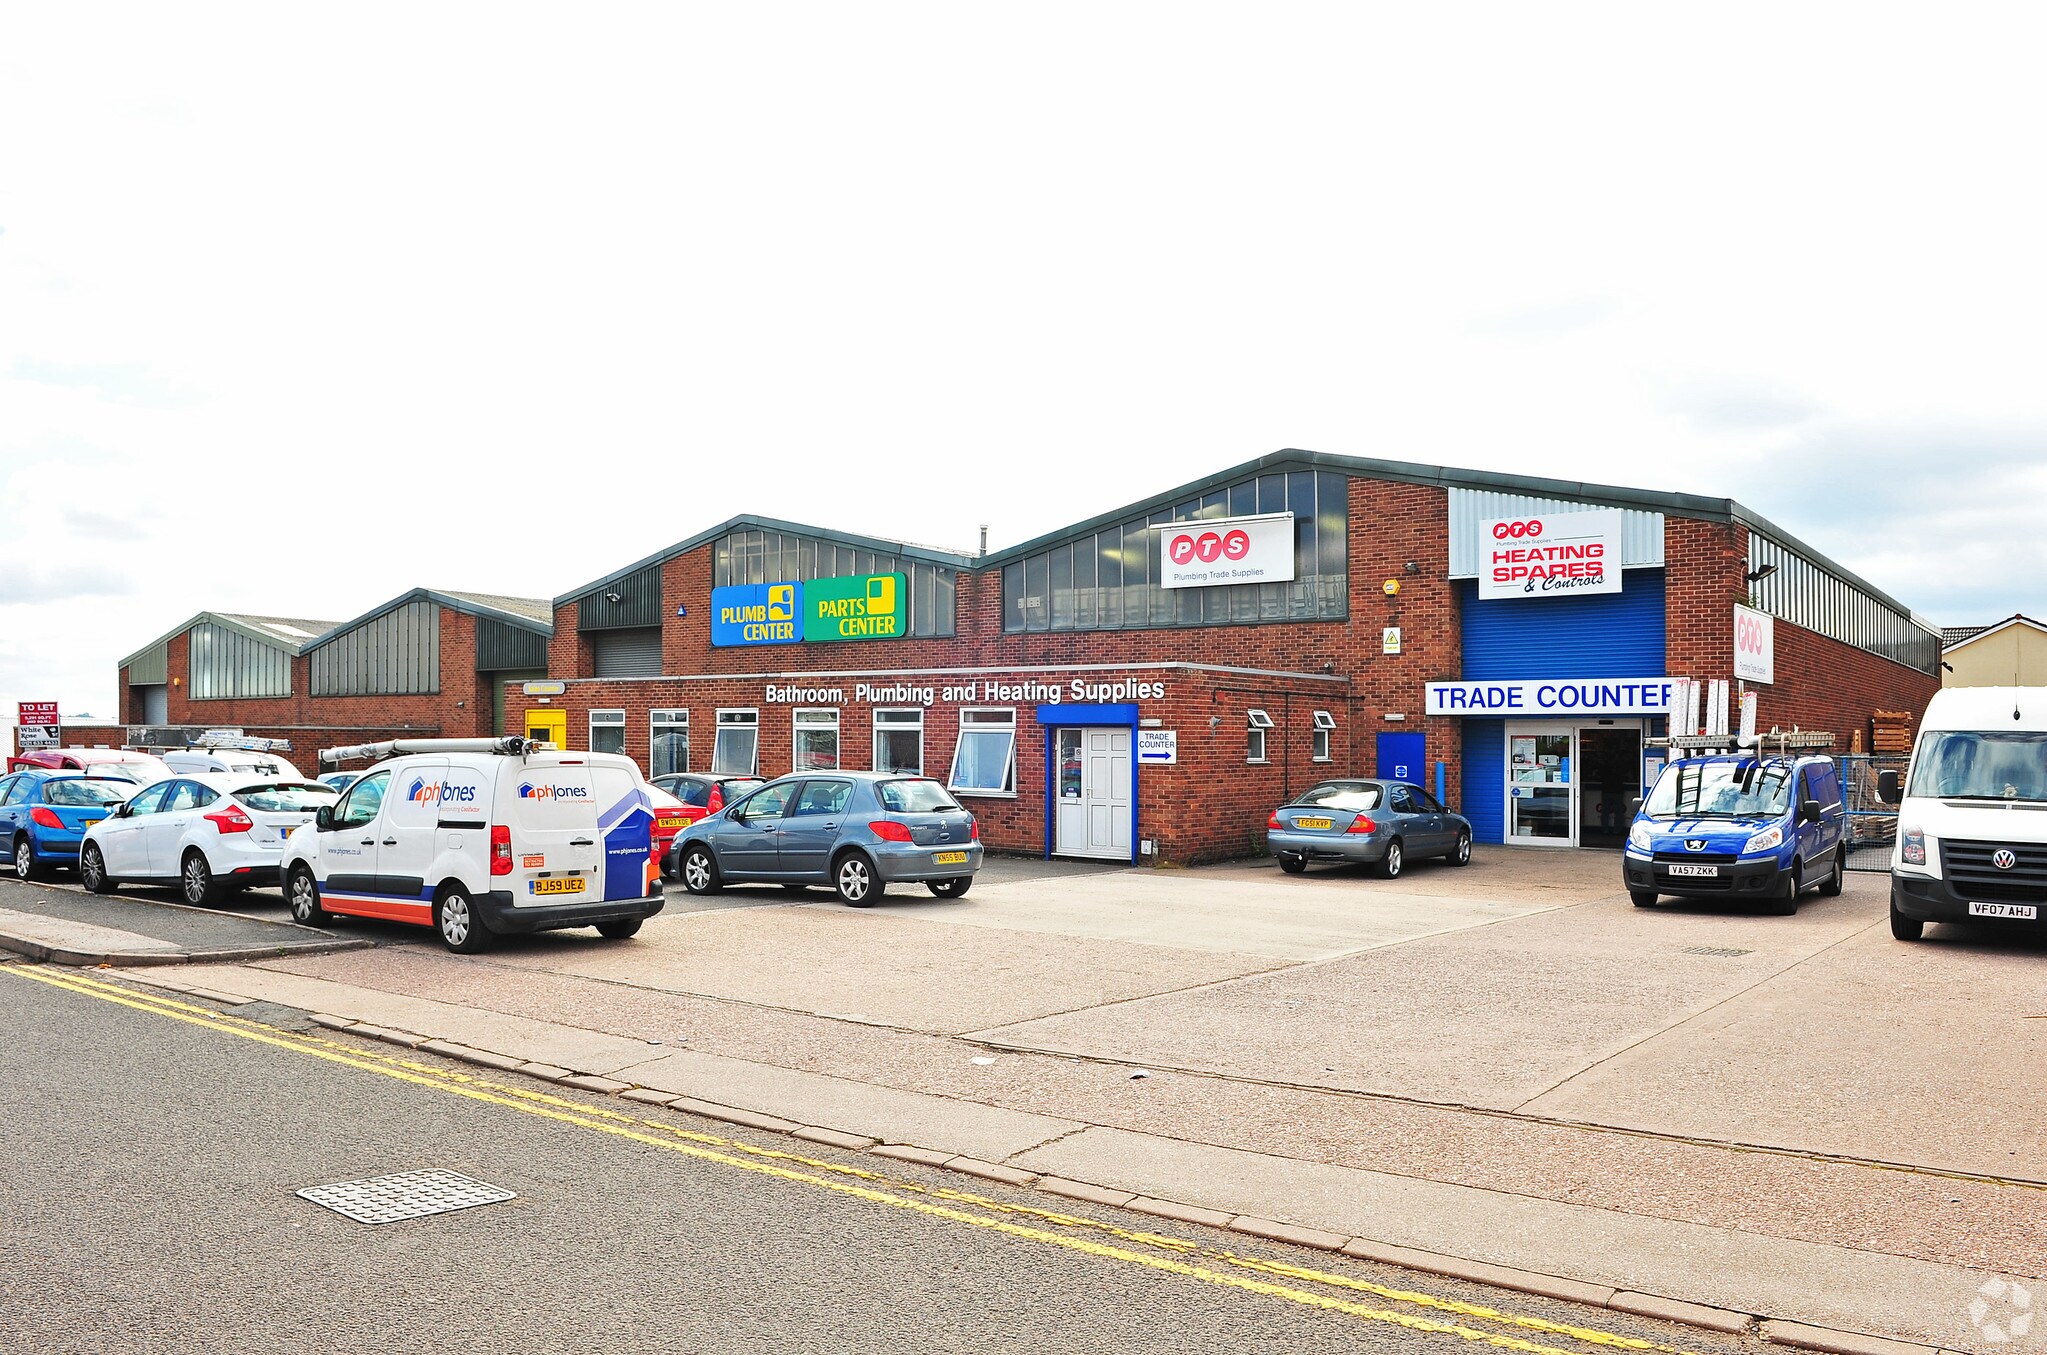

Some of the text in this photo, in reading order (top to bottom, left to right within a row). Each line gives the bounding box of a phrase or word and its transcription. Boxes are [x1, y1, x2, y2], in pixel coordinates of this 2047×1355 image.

[1494, 521, 1541, 538] PTS
[1172, 533, 1247, 561] PTS
[1493, 544, 1604, 564] HEATING
[1174, 568, 1265, 581] Plumbing Trade Supplies
[1493, 561, 1603, 582] SPARES
[1524, 571, 1606, 592] & Controls
[721, 605, 767, 624] PLUMB
[818, 598, 865, 618] PARTS
[743, 622, 794, 641] CENTER
[839, 616, 896, 636] CENTER
[1739, 619, 1761, 651] PTS
[766, 678, 1165, 706] Bathroom, Plumbing and Heating Supplies
[1433, 687, 1523, 708] TRADE
[608, 846, 648, 855] www.phjones.co.uk
[1672, 866, 1714, 875] VA57 ZKK
[535, 880, 583, 892] BJ59 UEZ
[1974, 903, 2032, 917] VF07 AHJ
